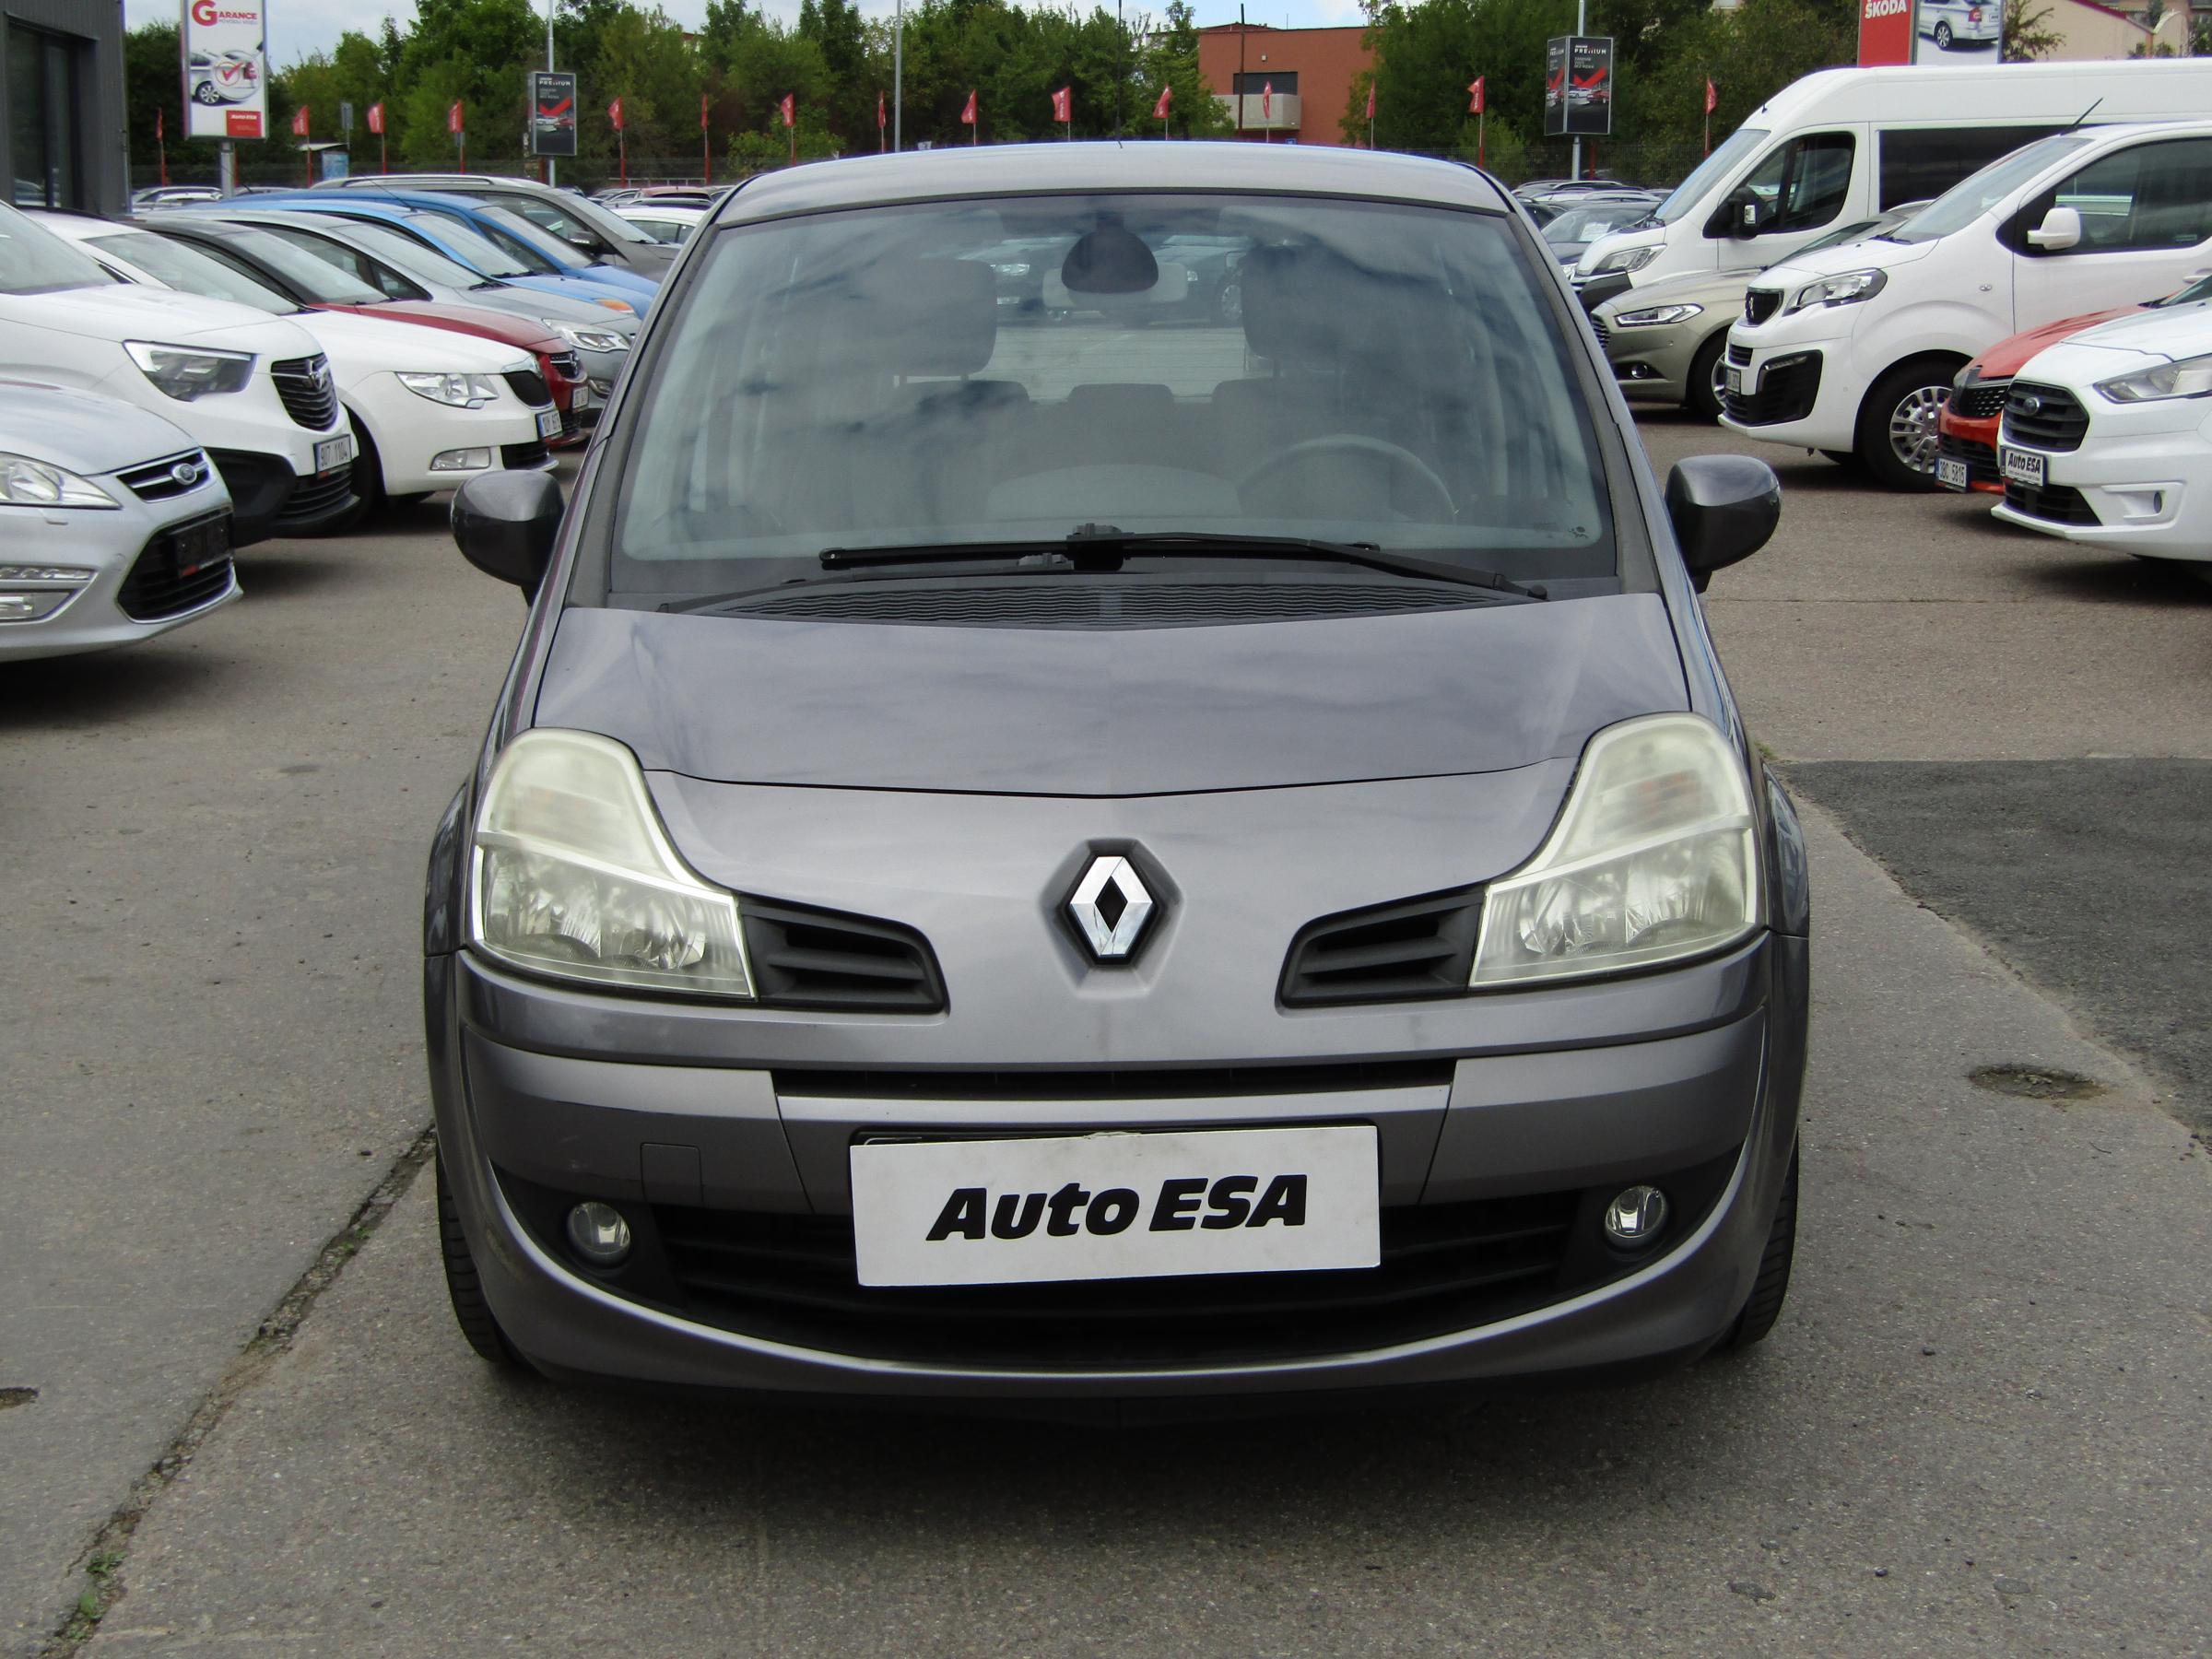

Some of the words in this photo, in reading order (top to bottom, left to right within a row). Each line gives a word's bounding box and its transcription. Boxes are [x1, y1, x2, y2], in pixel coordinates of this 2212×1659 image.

[2007, 453, 2026, 470] Auto
[2026, 456, 2041, 474] ESA
[925, 1182, 1140, 1241] Auto
[1148, 1174, 1308, 1232] ESA
